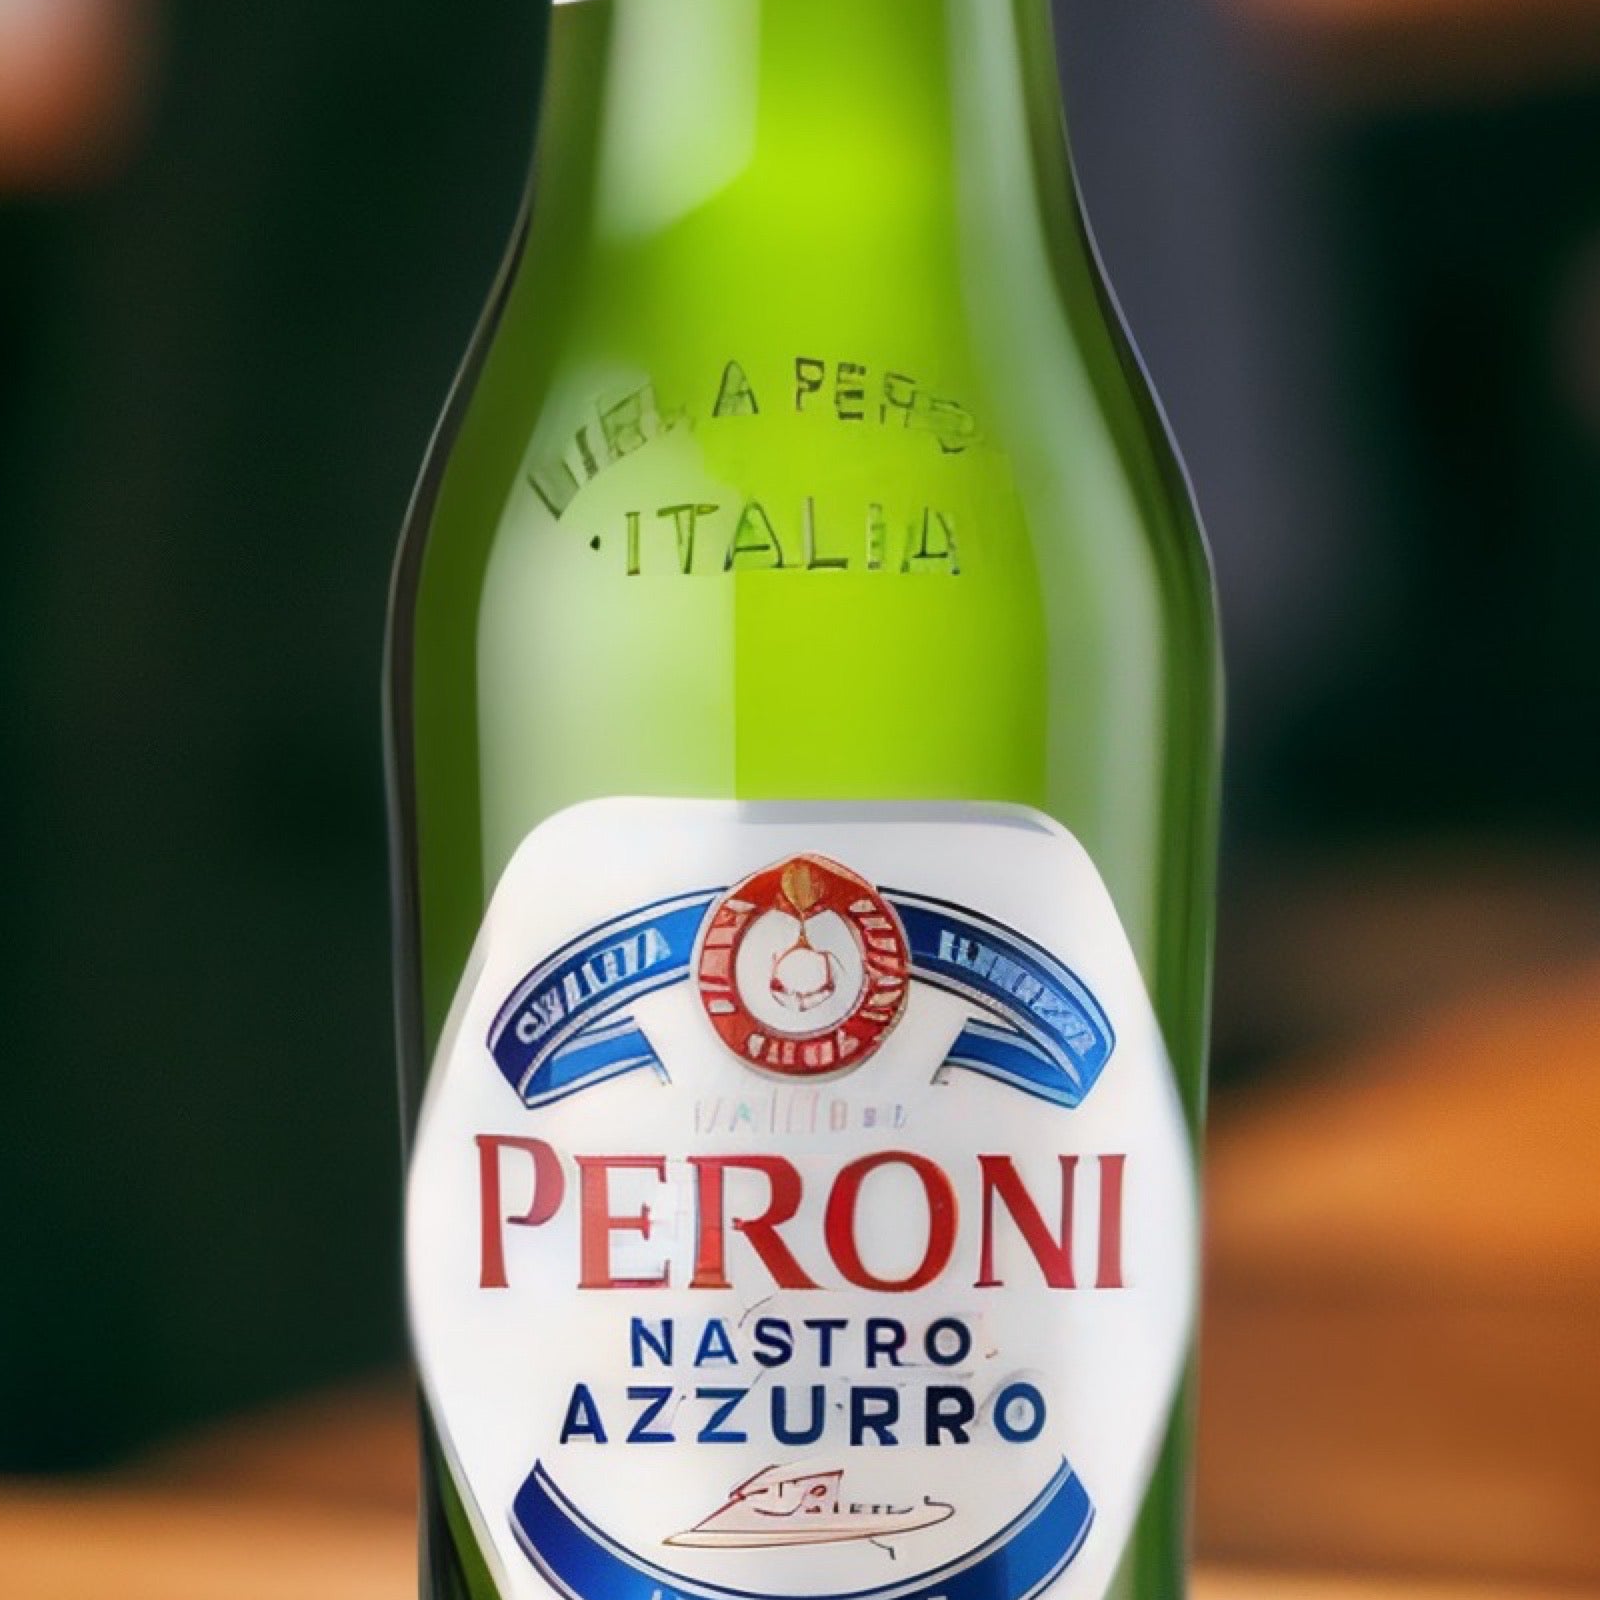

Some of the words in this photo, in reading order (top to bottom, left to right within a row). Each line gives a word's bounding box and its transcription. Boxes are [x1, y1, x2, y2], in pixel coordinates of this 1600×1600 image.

[474, 1133, 1130, 1293] PERONI
[629, 1316, 973, 1368] NASTRO
[559, 1381, 1048, 1447] AZZURRO
